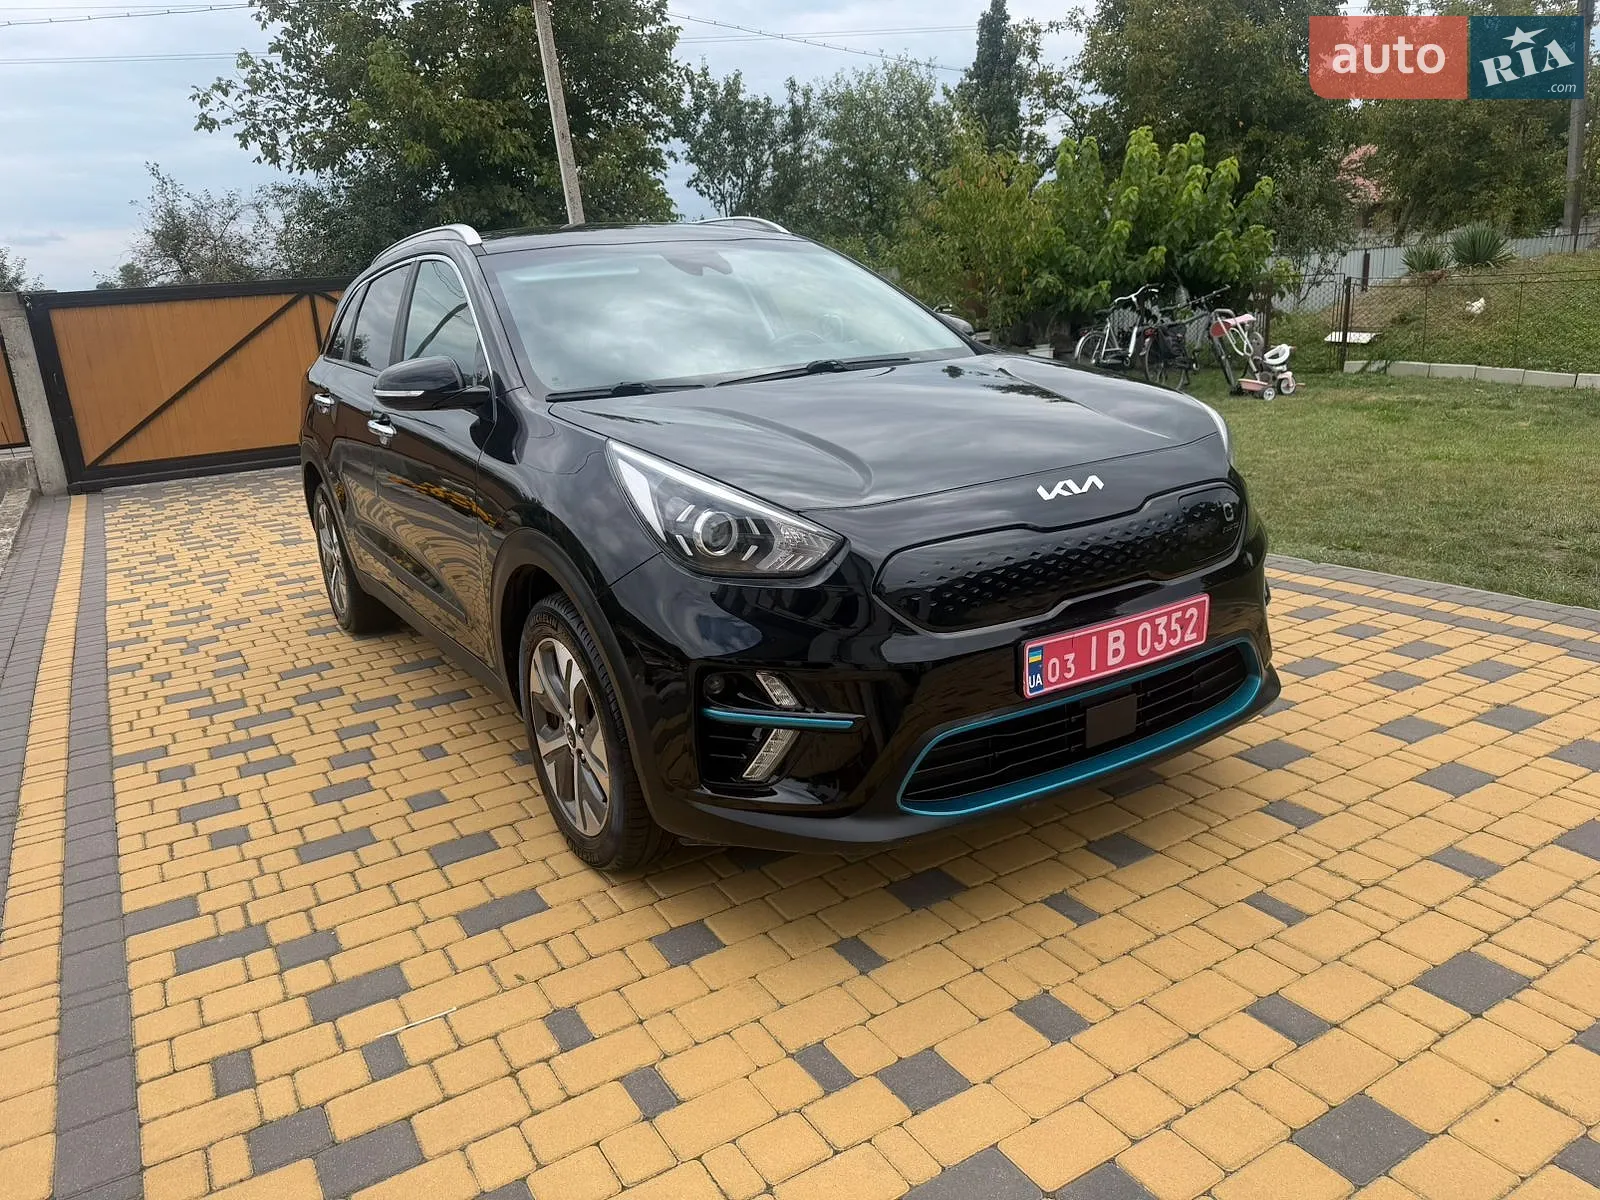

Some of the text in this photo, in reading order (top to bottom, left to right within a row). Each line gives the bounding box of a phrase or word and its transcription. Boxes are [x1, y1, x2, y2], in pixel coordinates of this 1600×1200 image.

[1047, 652, 1076, 683] 03
[1137, 607, 1198, 657] 0352
[1028, 673, 1043, 689] UA
